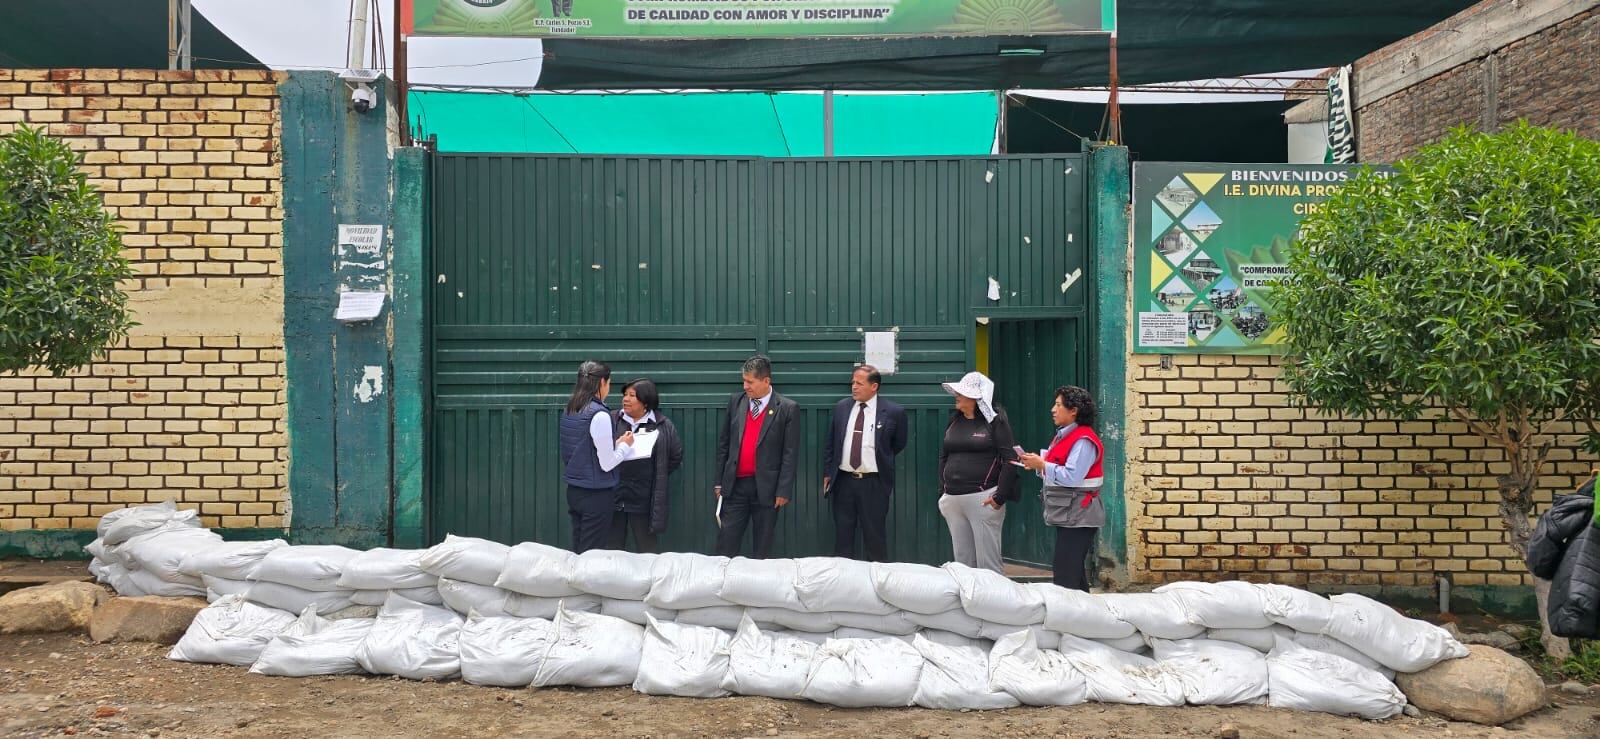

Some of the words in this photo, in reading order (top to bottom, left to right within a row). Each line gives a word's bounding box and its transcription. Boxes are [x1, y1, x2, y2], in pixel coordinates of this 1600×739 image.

[627, 9, 646, 20] DE
[649, 9, 710, 20] CALIDAD
[713, 9, 743, 20] CON
[746, 9, 788, 20] AMOR
[791, 9, 800, 20] Y
[1231, 170, 1348, 182] BIENVENIDOS
[1224, 184, 1244, 196] I.E.
[1249, 184, 1301, 197] DIVINA
